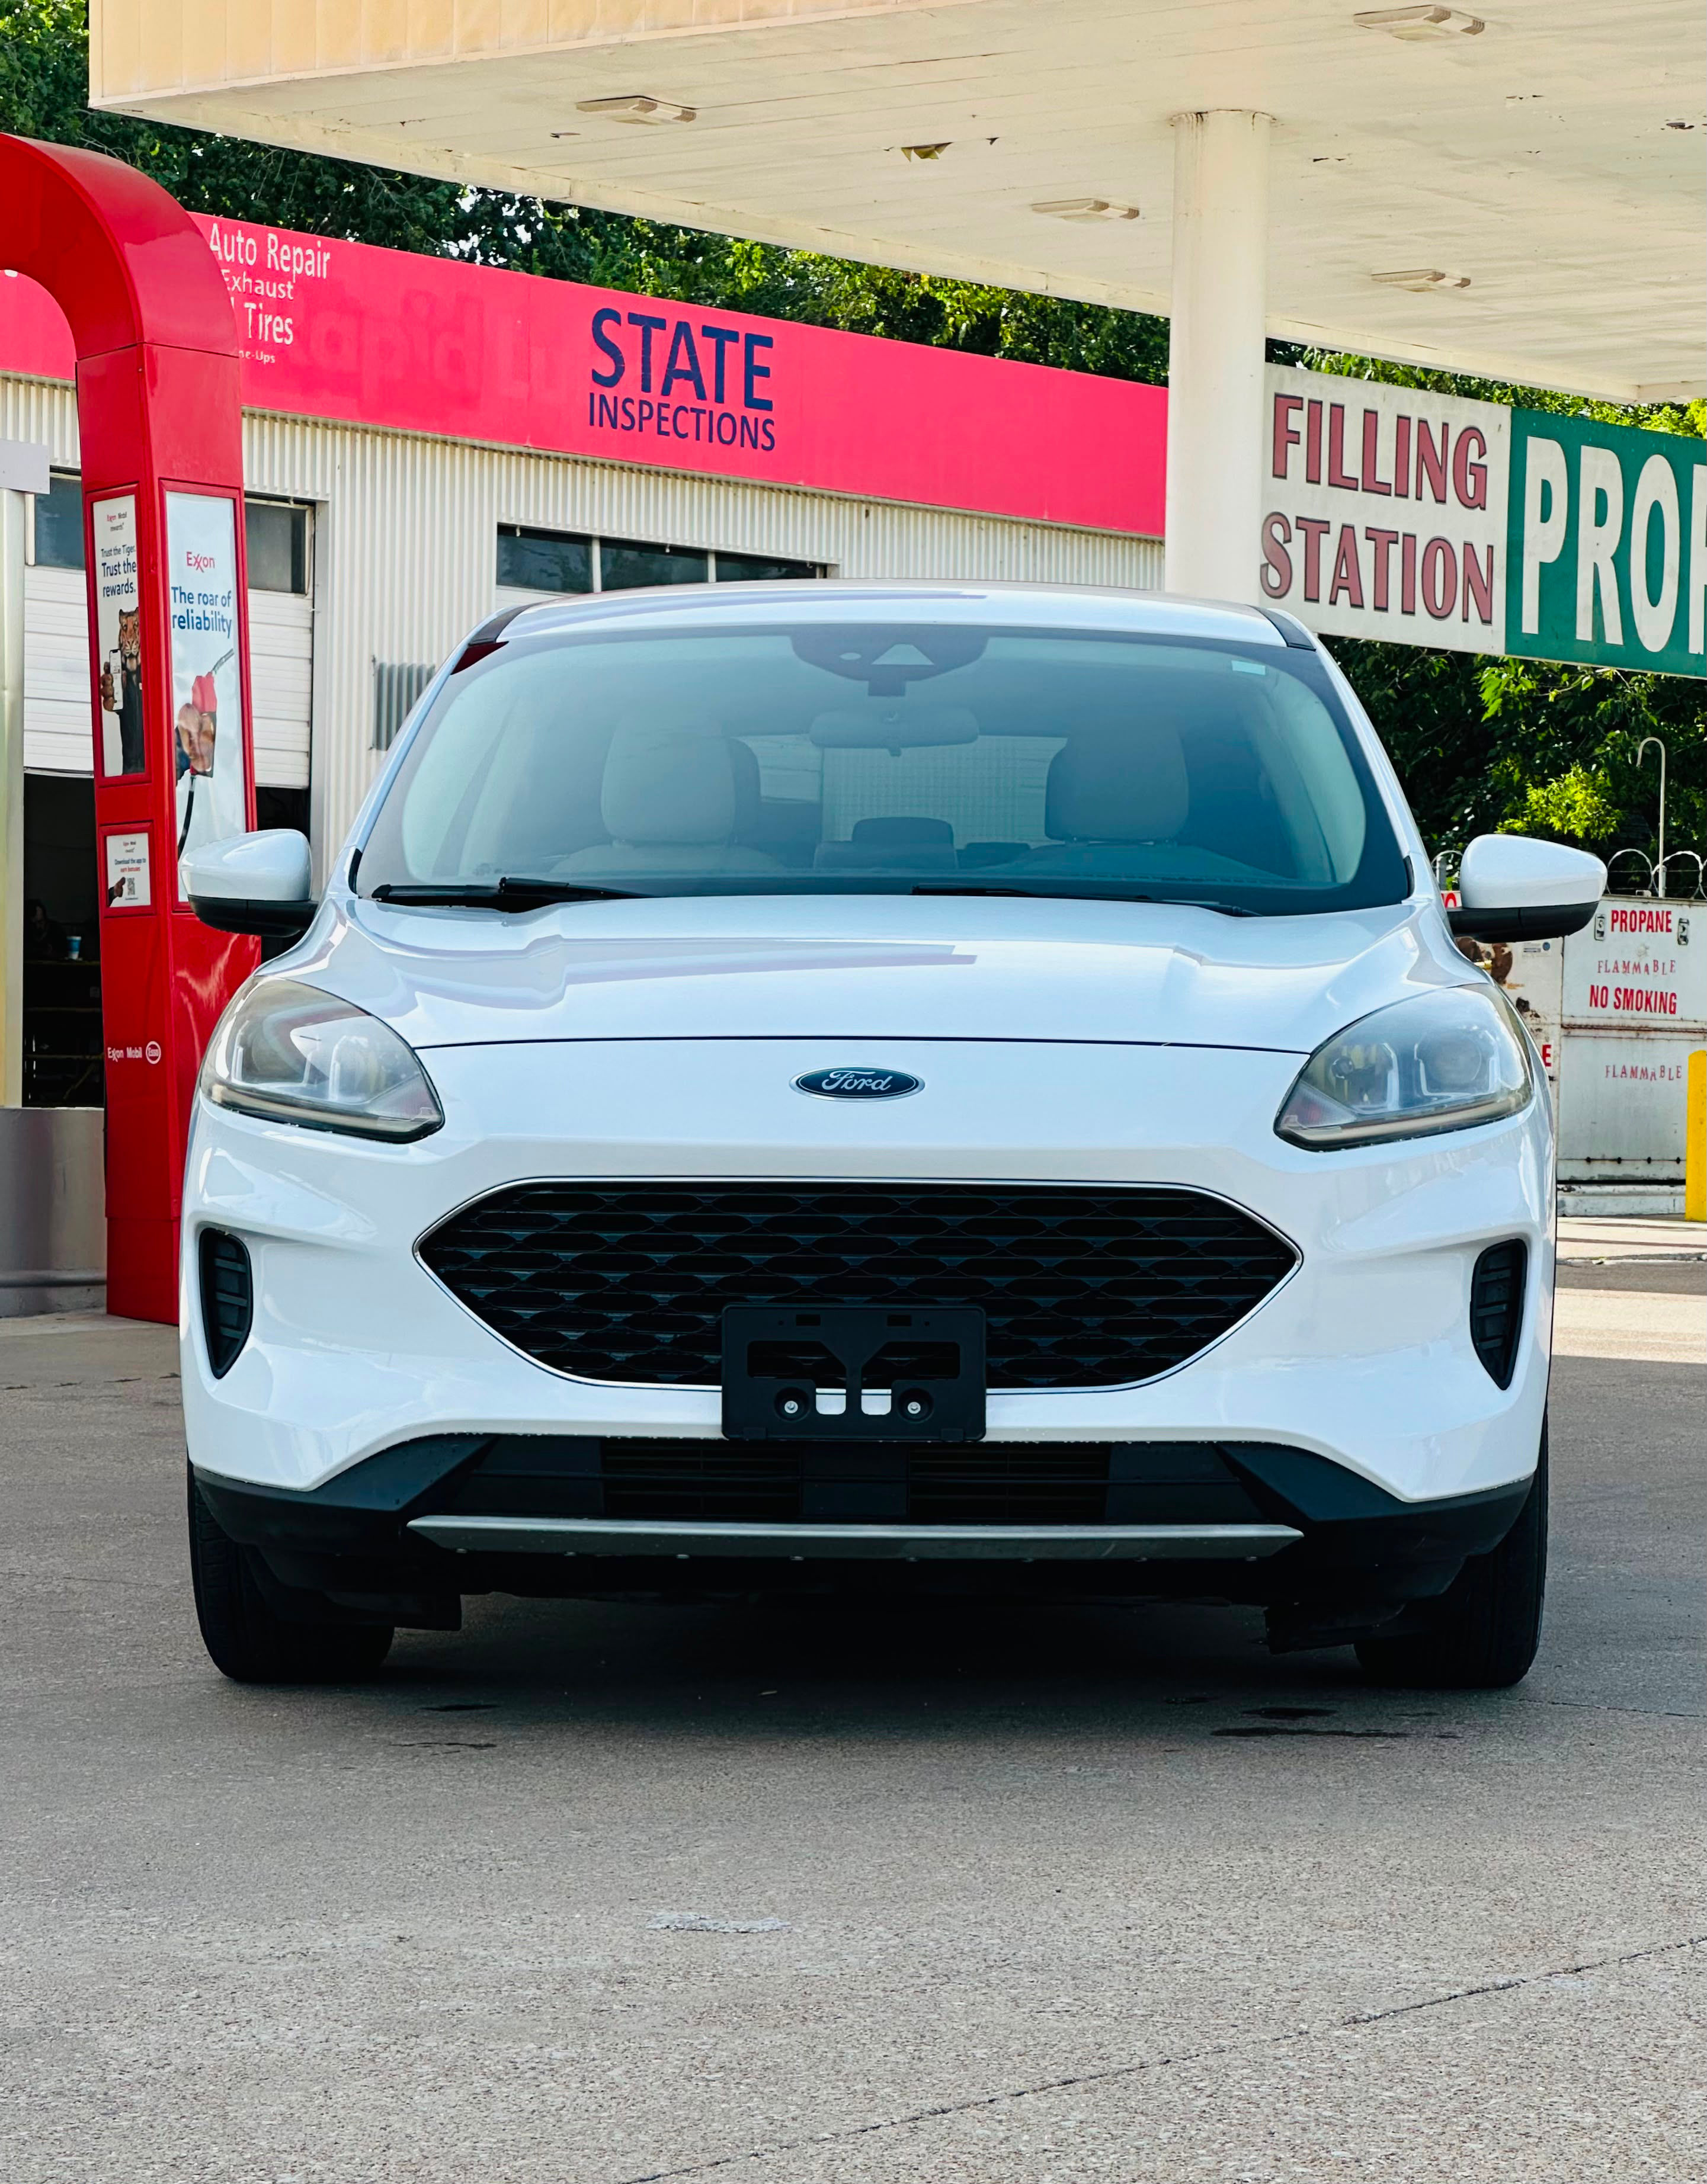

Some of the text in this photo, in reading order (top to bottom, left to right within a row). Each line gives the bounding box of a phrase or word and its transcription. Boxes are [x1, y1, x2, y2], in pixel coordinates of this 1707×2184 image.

[210, 223, 331, 283] Auto Repair
[244, 303, 294, 345] Tires
[591, 307, 773, 411] STATE
[589, 392, 775, 451] INSPECTIONS
[1272, 392, 1487, 511] FILLING
[101, 548, 113, 557] Trust
[187, 551, 215, 573] Exxon
[101, 557, 137, 578] Trust the
[1260, 511, 1494, 626] STATION
[103, 578, 136, 598] rewards.
[171, 586, 232, 608] The roar of
[172, 609, 232, 639] reliability
[1611, 910, 1672, 933] PROPANE
[1597, 959, 1676, 976] FLAMMABLE
[1589, 984, 1677, 1015] NO SMOKING
[107, 1047, 142, 1063] Exxon Mobil
[821, 1070, 893, 1091] Ford
[1605, 1065, 1682, 1082] FLAMMABLE
